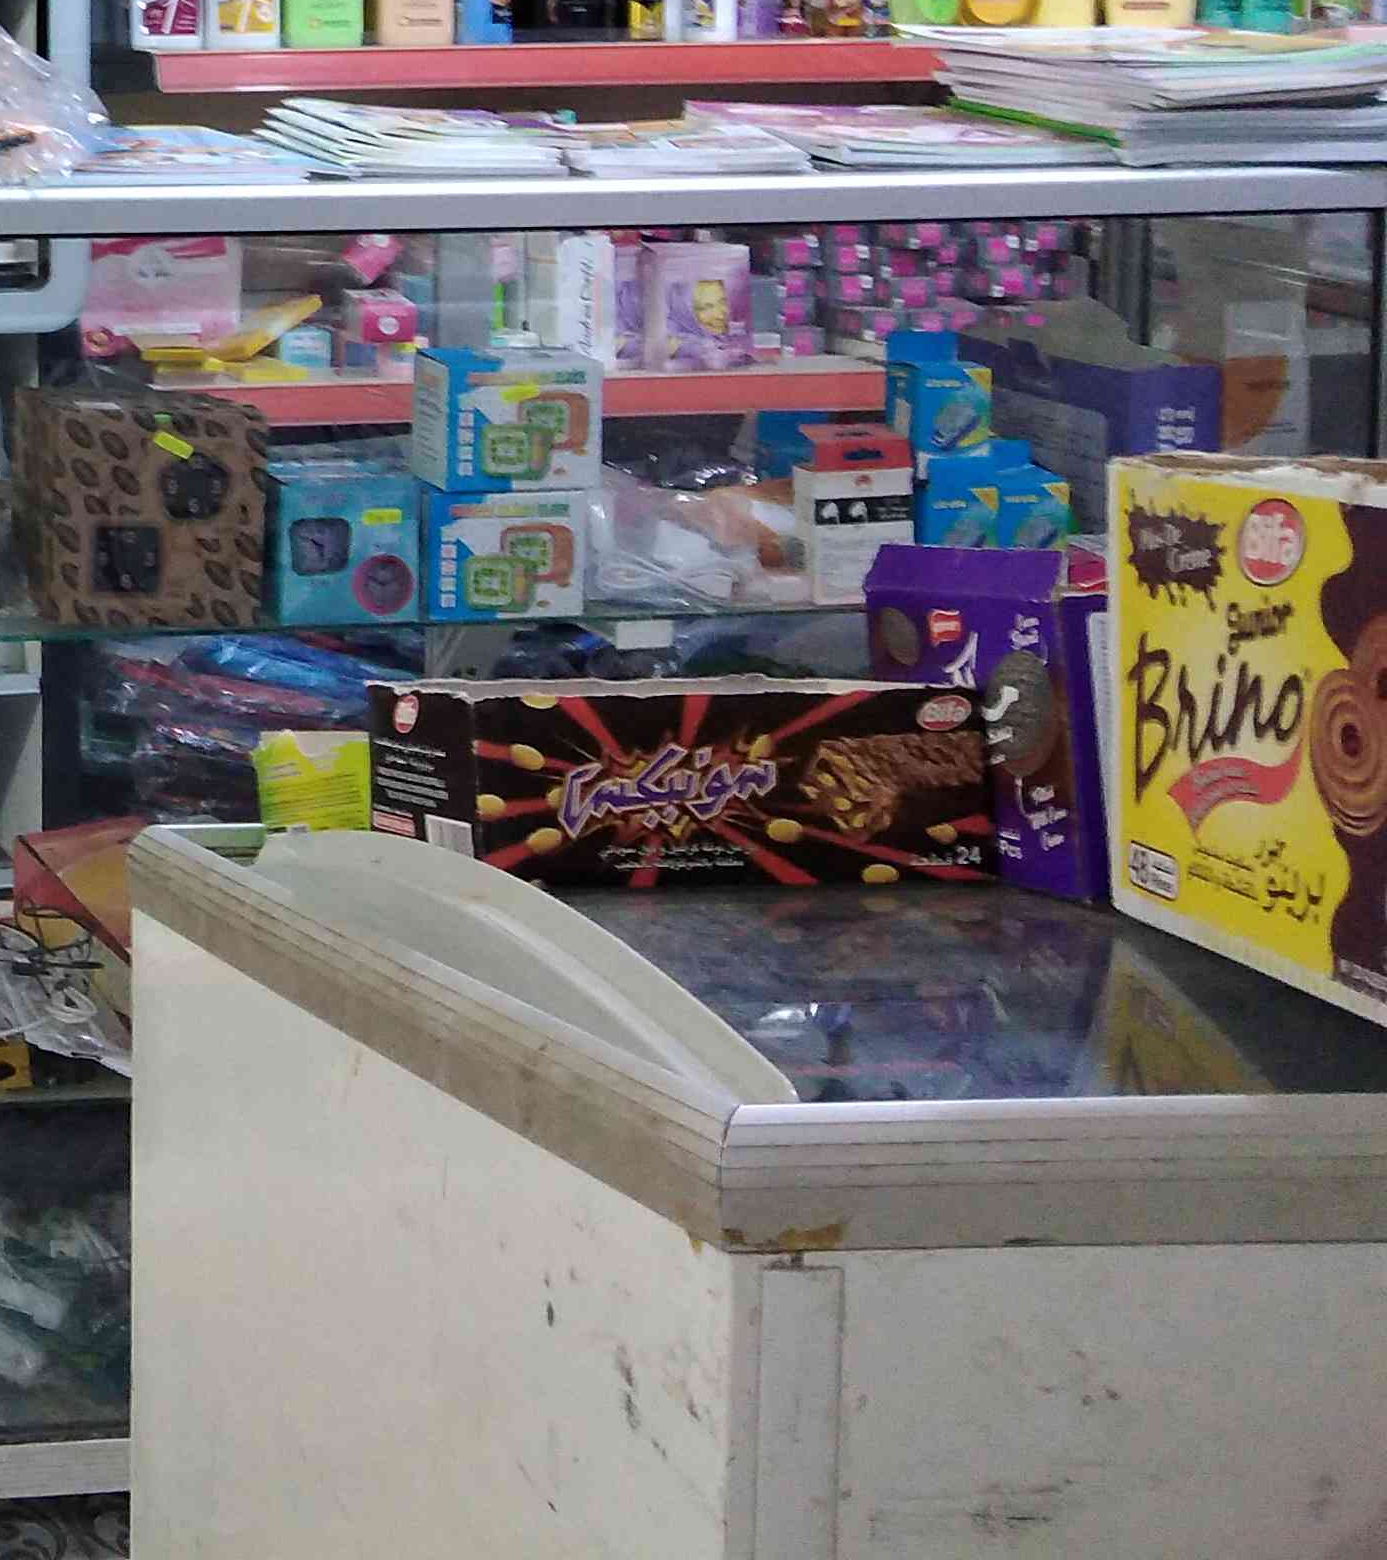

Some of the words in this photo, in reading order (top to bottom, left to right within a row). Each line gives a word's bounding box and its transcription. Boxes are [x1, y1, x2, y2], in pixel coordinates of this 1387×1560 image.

[1243, 510, 1304, 570] Bifa
[925, 701, 965, 721] Bifa
[1127, 630, 1305, 808] Brino
[955, 844, 983, 866] 24
